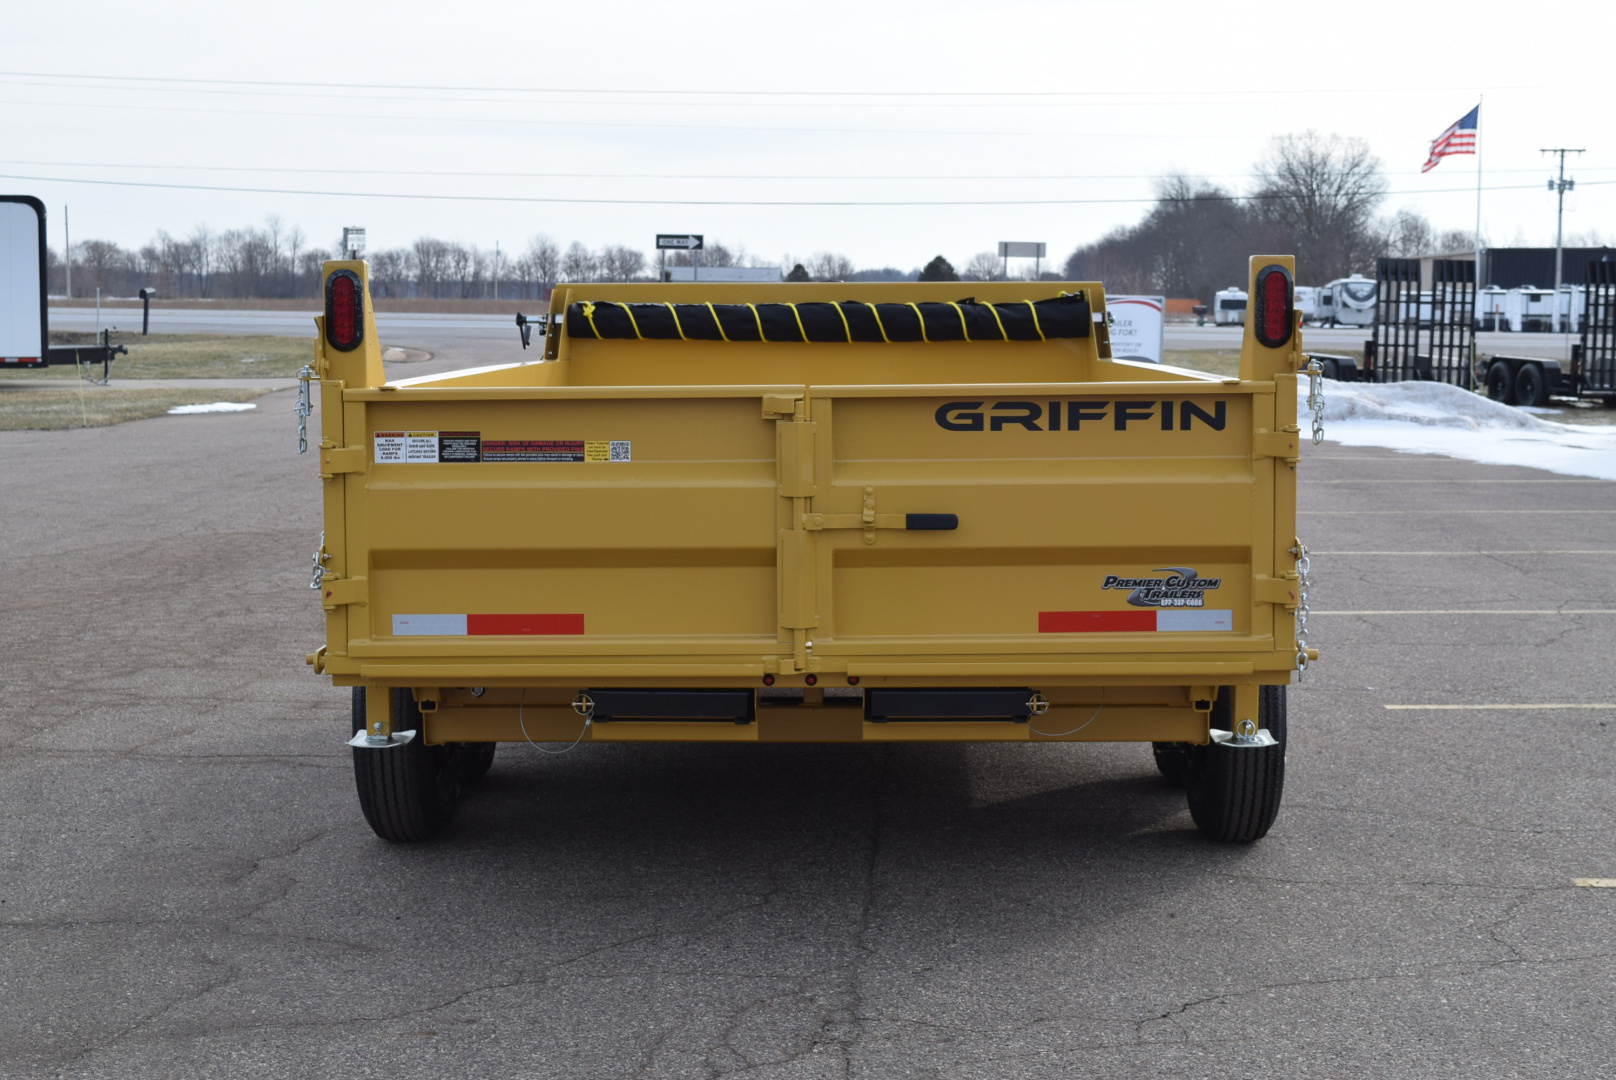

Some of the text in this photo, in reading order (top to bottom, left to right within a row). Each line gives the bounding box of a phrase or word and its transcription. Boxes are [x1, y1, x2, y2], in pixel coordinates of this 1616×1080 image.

[934, 400, 1226, 431] GRIFFIN
[1102, 576, 1221, 588] PREMIER CUSTOM
[1143, 588, 1204, 599] TRAILERS
